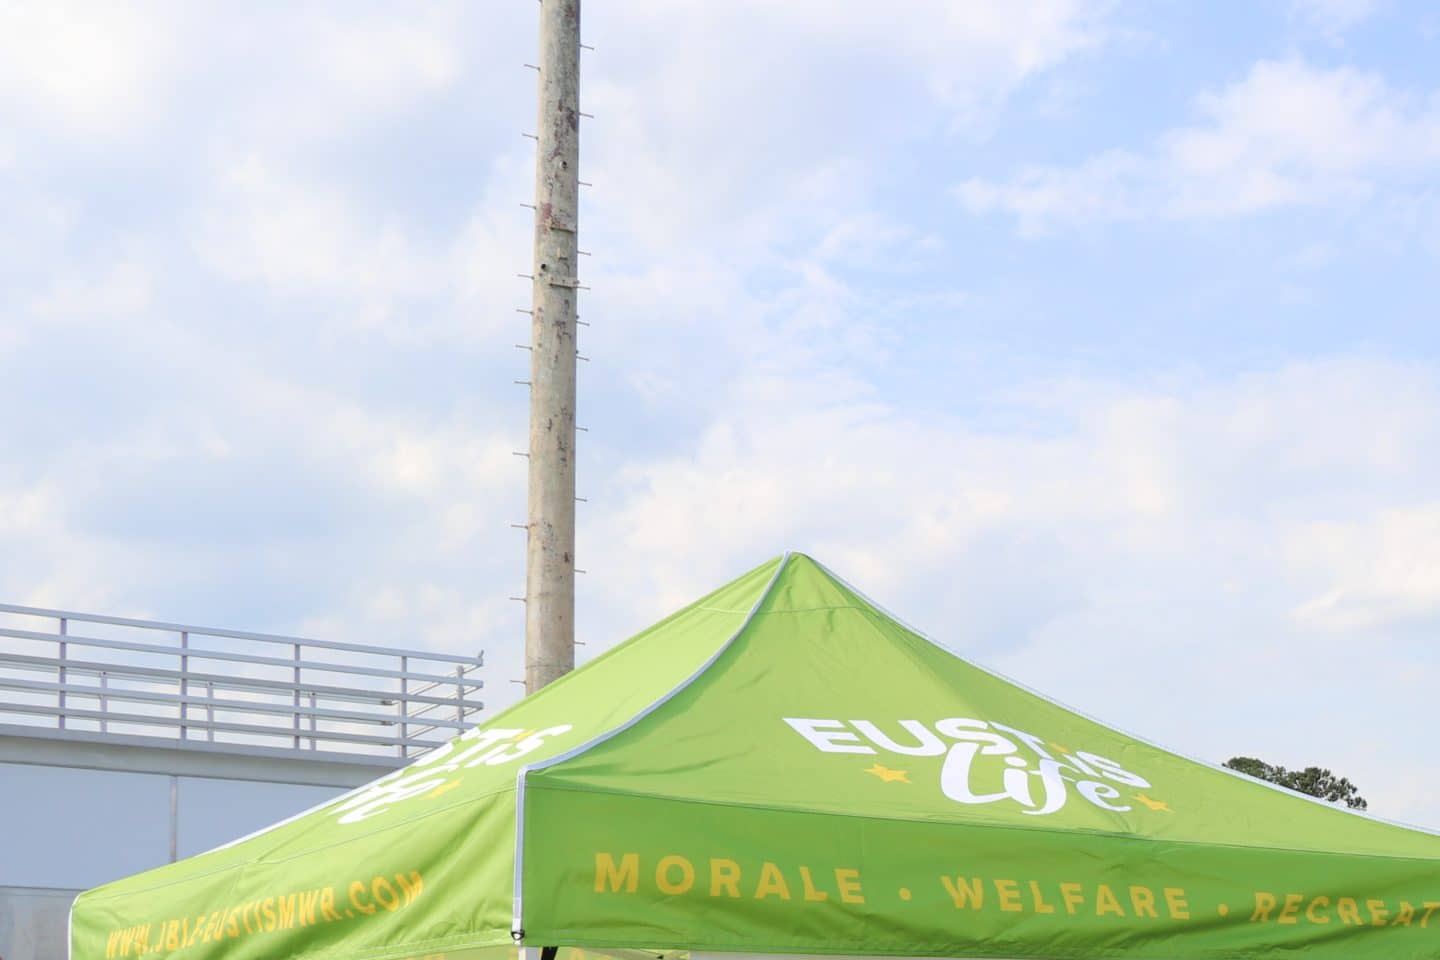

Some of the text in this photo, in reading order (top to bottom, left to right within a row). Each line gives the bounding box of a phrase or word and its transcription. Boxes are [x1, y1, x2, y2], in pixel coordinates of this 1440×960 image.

[782, 717, 1152, 789] EUSTIS
[593, 852, 866, 905] MORALE
[940, 875, 1190, 922] WELFARE
